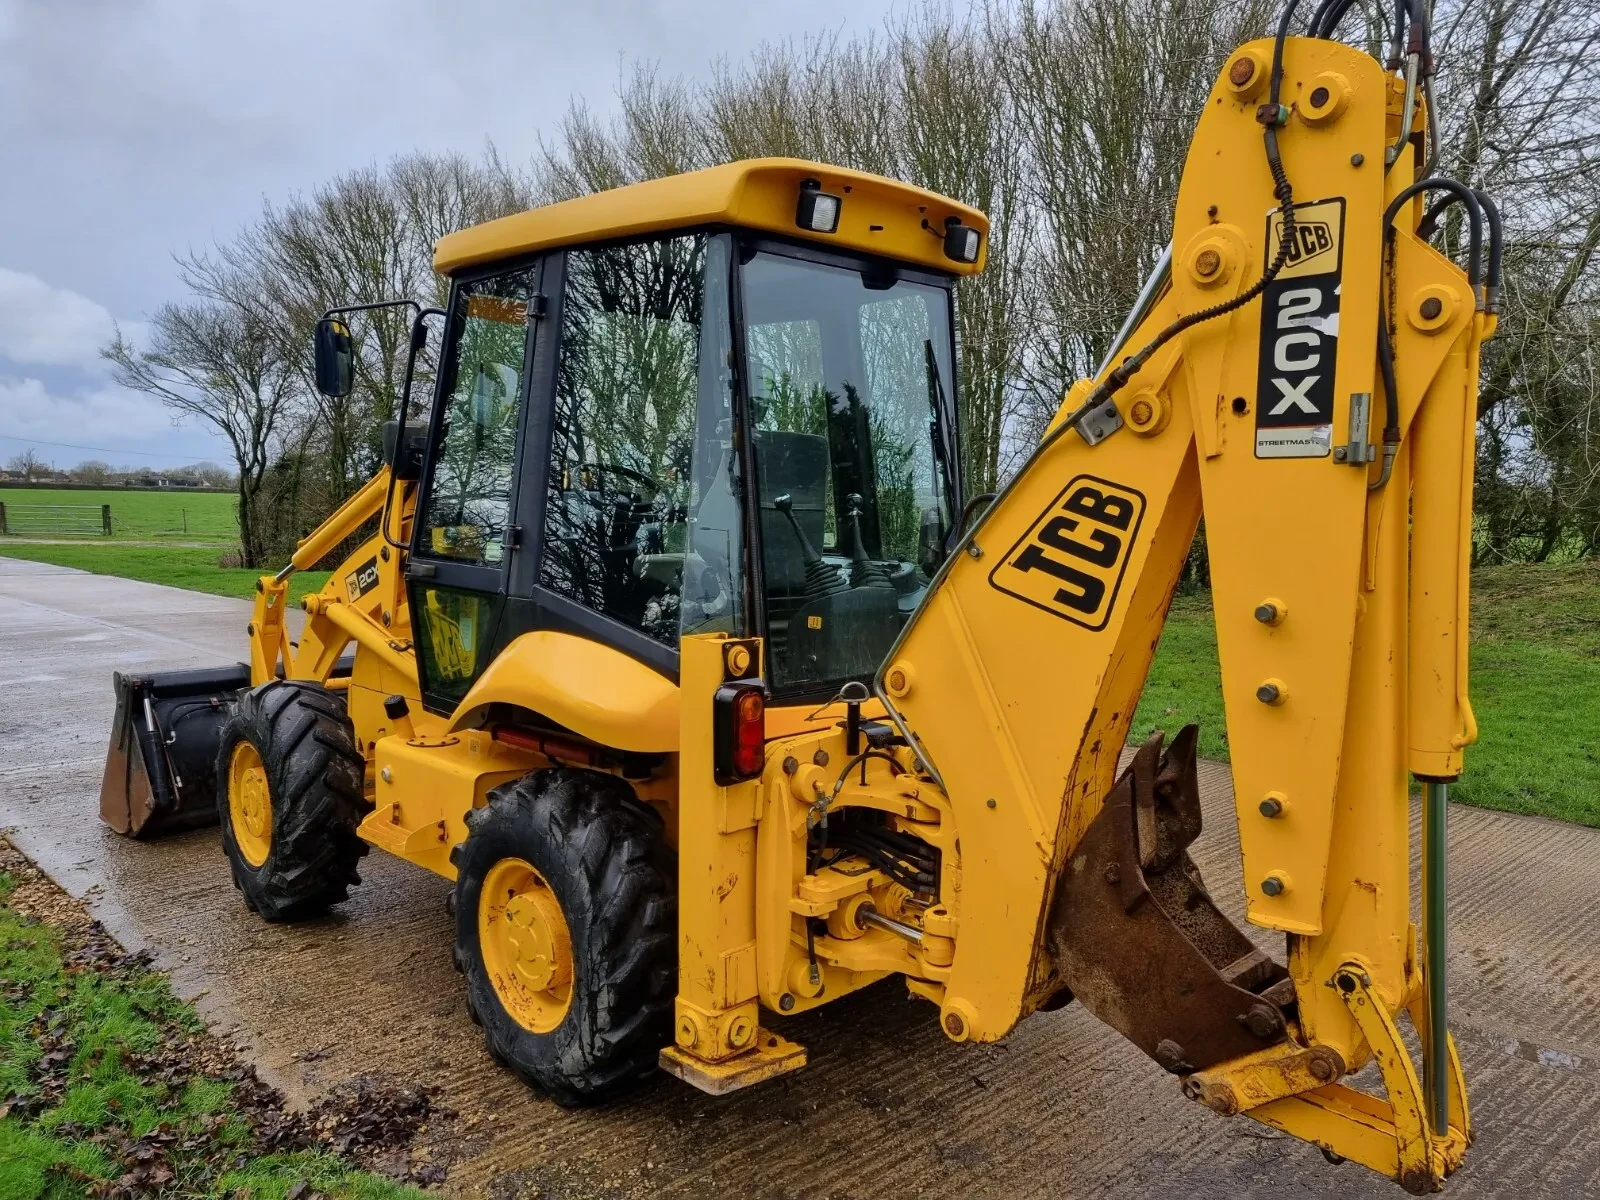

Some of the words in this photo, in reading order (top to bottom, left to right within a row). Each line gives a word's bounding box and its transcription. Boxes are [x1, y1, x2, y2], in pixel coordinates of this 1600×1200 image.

[1286, 225, 1330, 262] JCB
[1268, 287, 1322, 415] 2CX
[359, 564, 378, 588] 2CX
[1011, 486, 1134, 614] JCB
